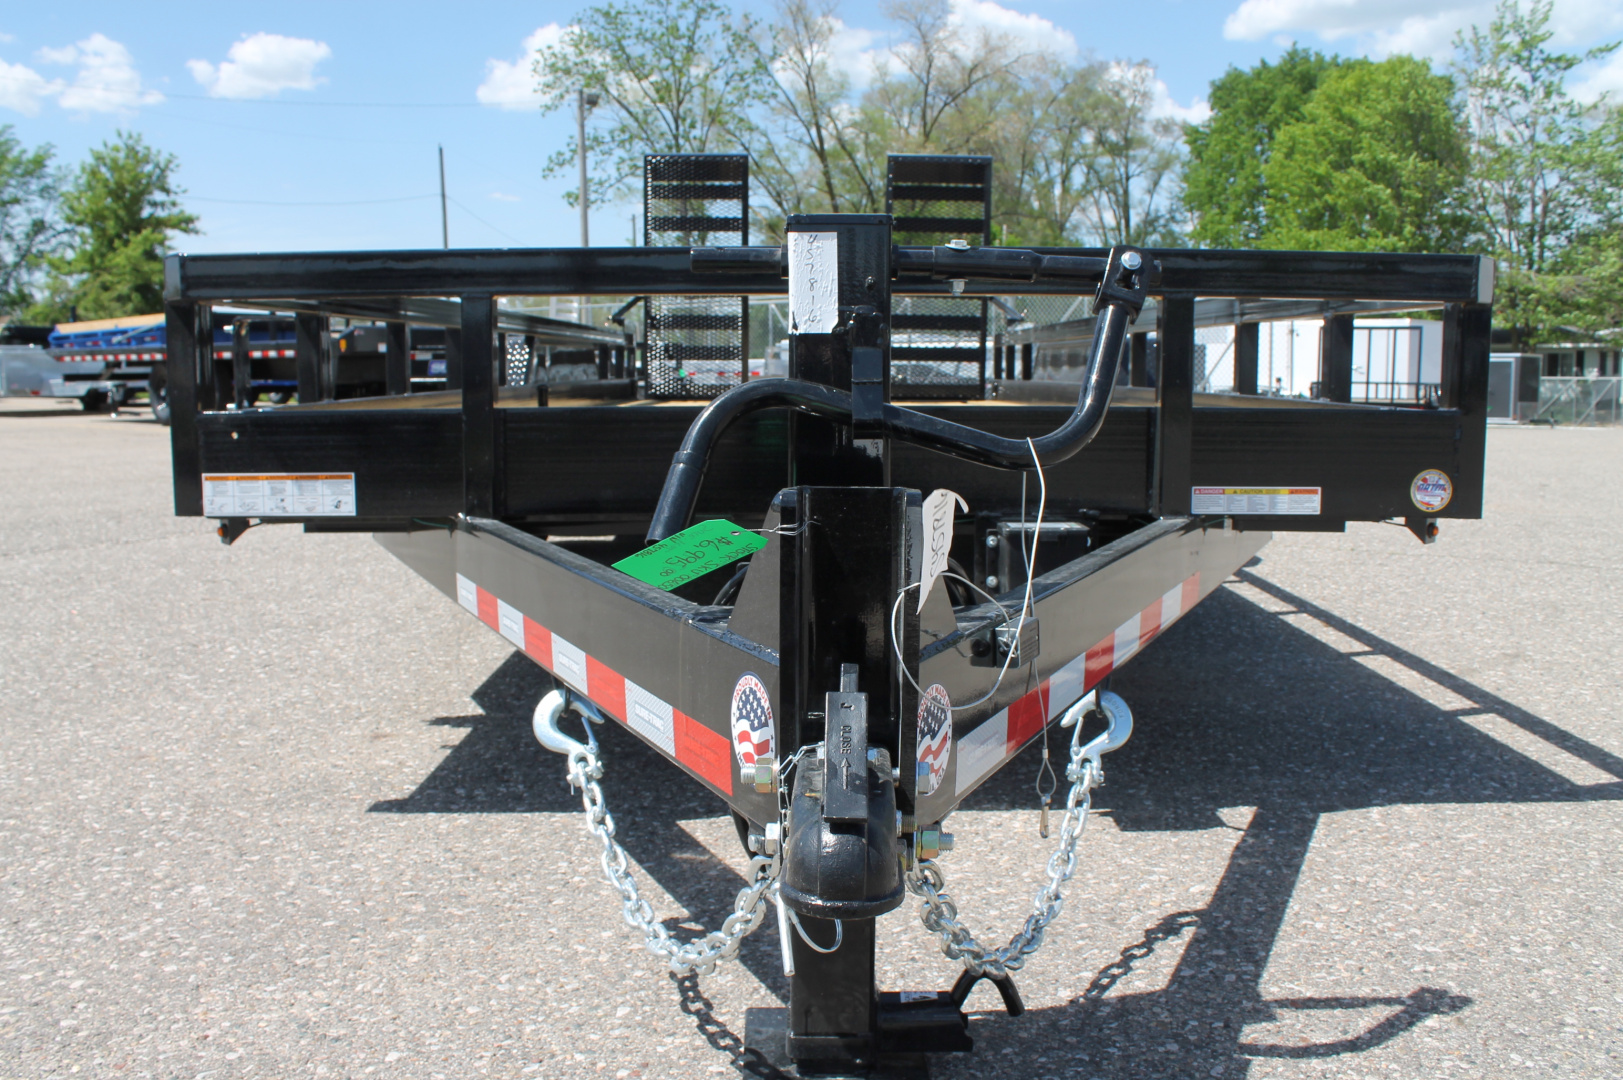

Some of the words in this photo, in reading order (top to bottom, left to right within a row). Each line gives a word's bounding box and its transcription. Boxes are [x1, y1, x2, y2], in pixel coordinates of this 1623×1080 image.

[734, 676, 753, 704] PROUDLY
[754, 680, 768, 706] MADE
[766, 705, 774, 721] IN
[840, 724, 852, 755] CLOSE
